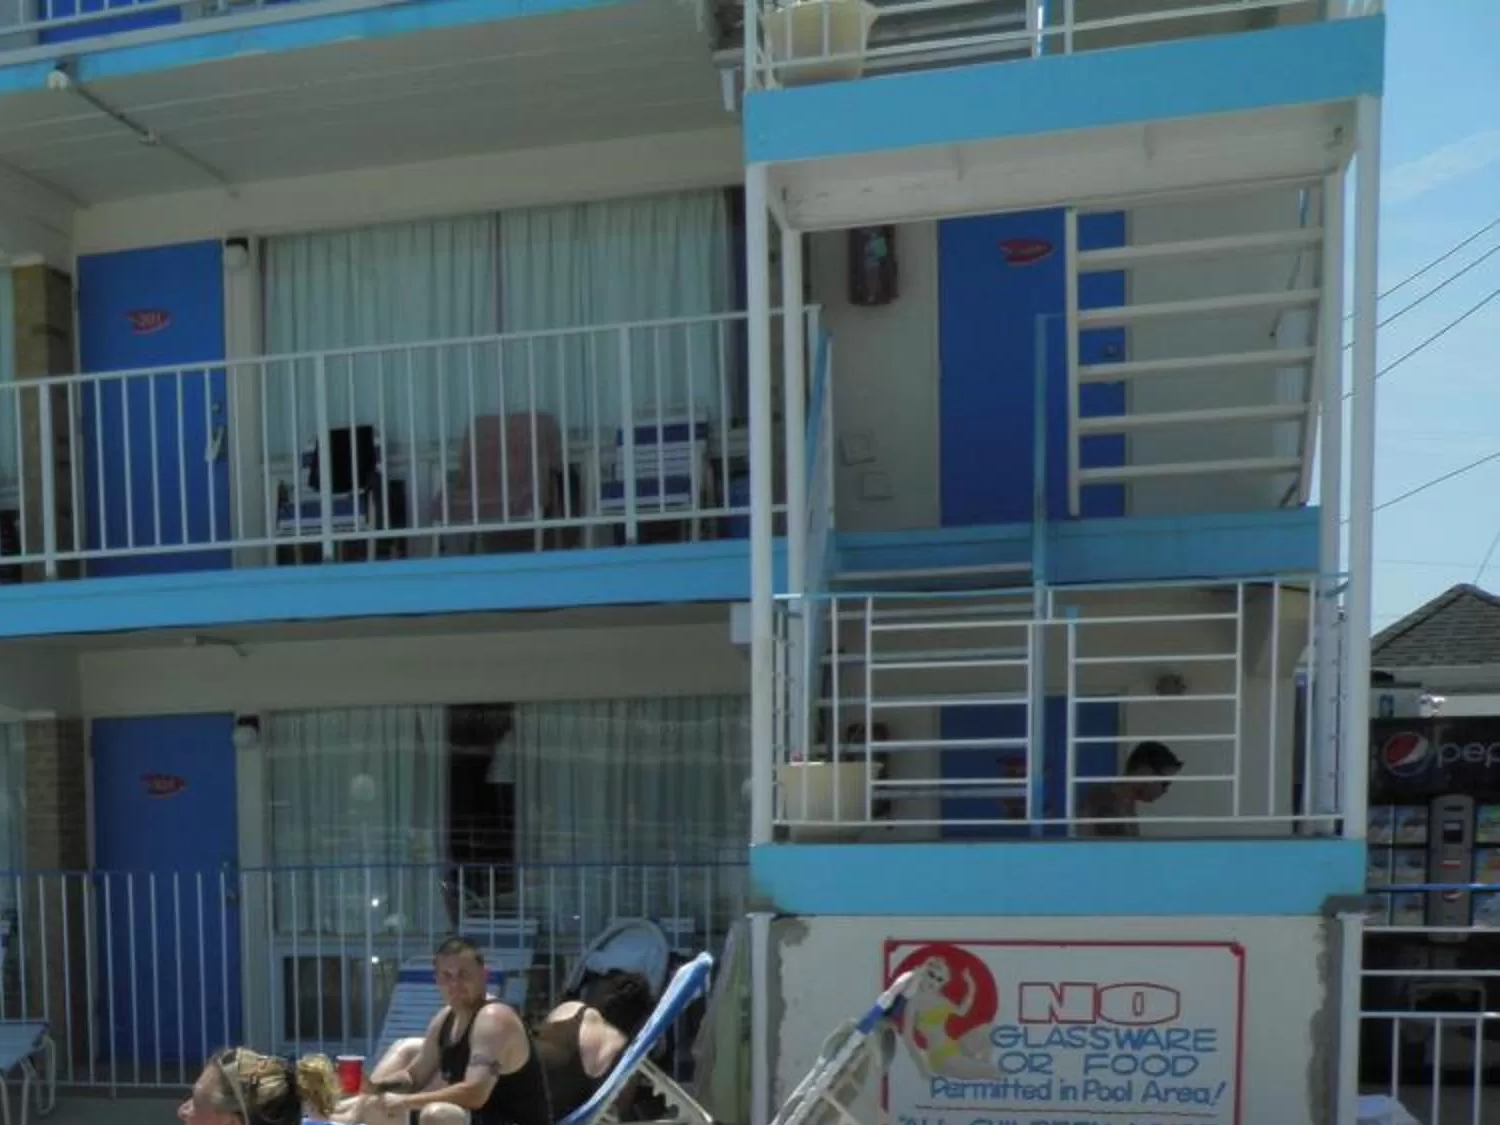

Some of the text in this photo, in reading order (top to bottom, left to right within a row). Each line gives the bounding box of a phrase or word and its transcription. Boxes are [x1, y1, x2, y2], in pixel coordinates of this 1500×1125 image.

[1018, 981, 1181, 1026] NO
[989, 1025, 1217, 1052] GLASSWARE
[998, 1051, 1199, 1078] OR FOOD
[930, 1075, 1227, 1107] Permitted in Pool Area!
